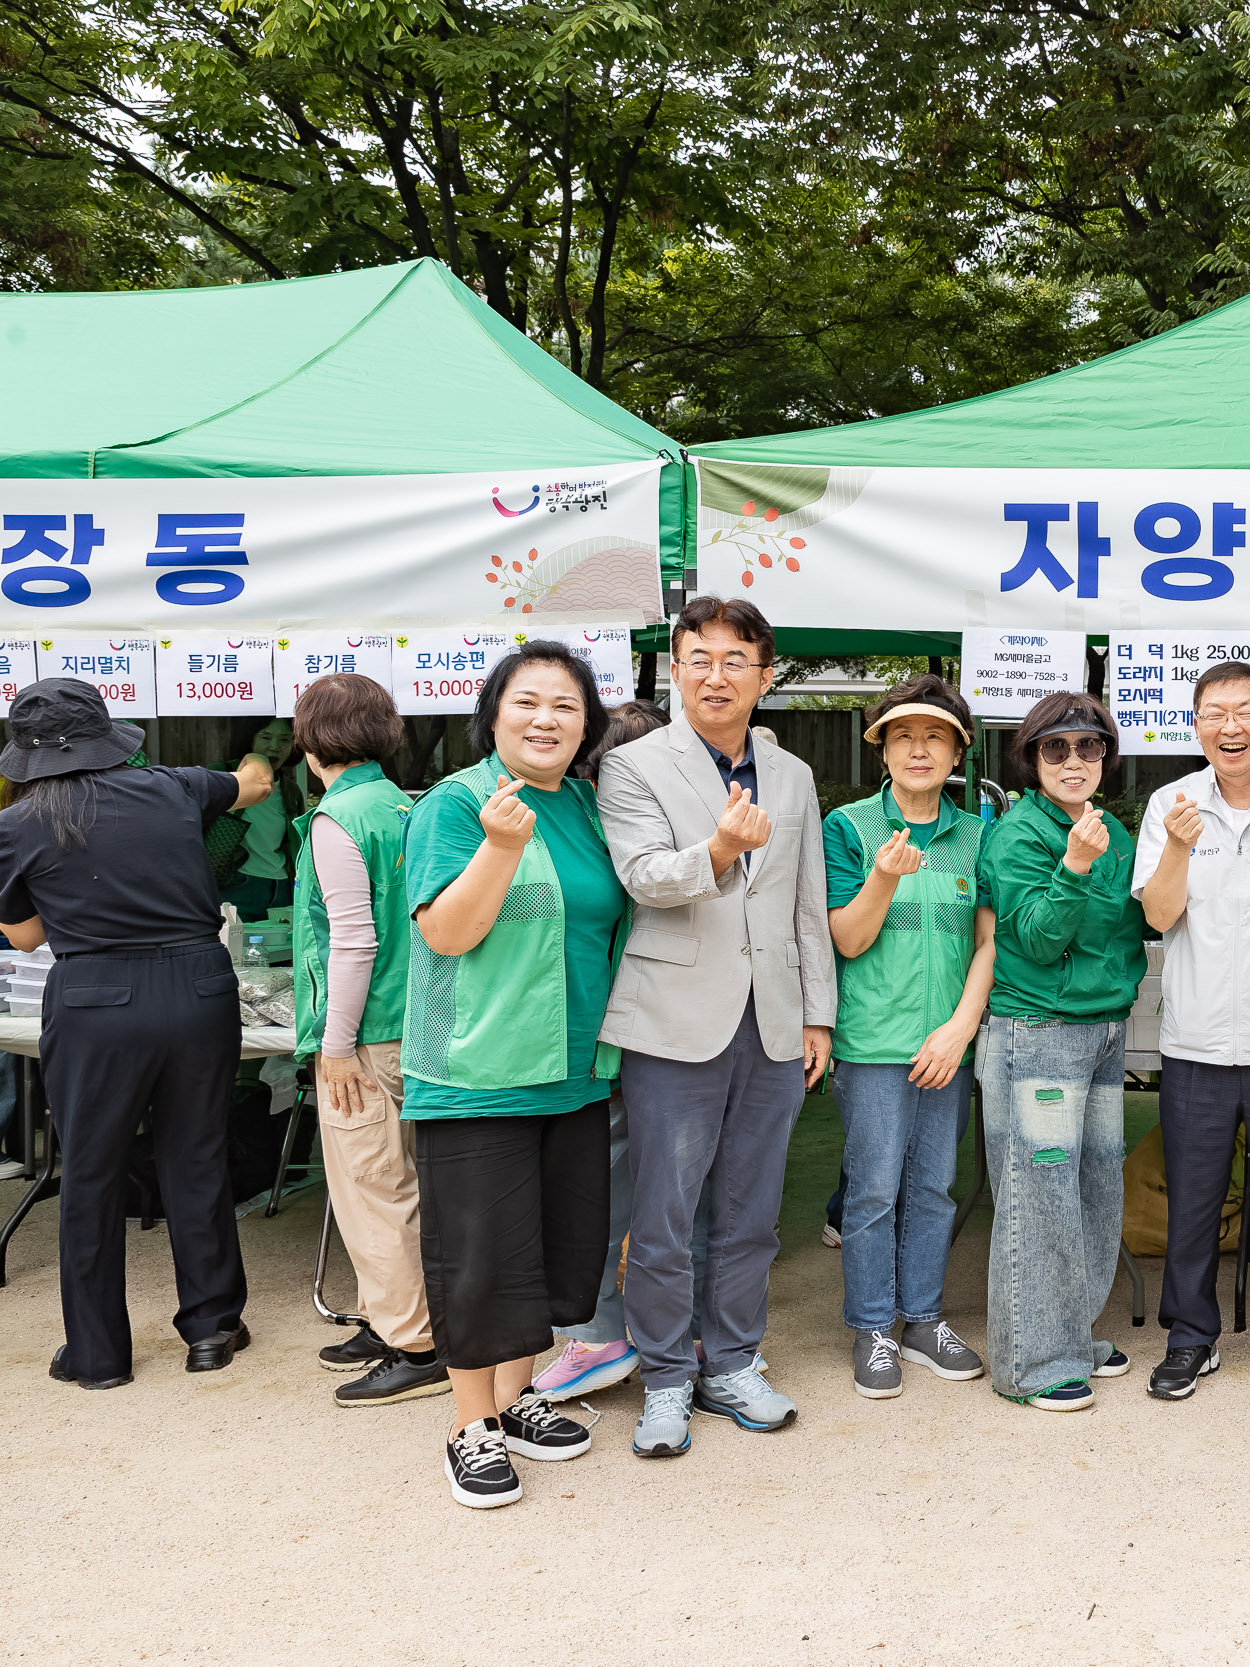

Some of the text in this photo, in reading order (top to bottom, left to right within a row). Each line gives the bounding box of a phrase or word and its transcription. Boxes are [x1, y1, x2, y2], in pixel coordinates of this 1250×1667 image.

[415, 651, 485, 671] 모시송편
[995, 653, 1051, 664] MG새마을금고
[1171, 645, 1199, 661] 1kg
[61, 655, 130, 675] 지리멸치
[187, 654, 239, 673] 들기름
[304, 654, 357, 673] 참기름
[976, 669, 1068, 682] 9002-1890-7528-3
[1117, 665, 1164, 682] 도라지
[176, 682, 253, 701] 13,000원
[982, 686, 1013, 697] 자양1동
[1117, 687, 1163, 704] 모시떡
[1117, 710, 1194, 727] 뻥튀기(2개
[1160, 731, 1192, 742] 자양1동
